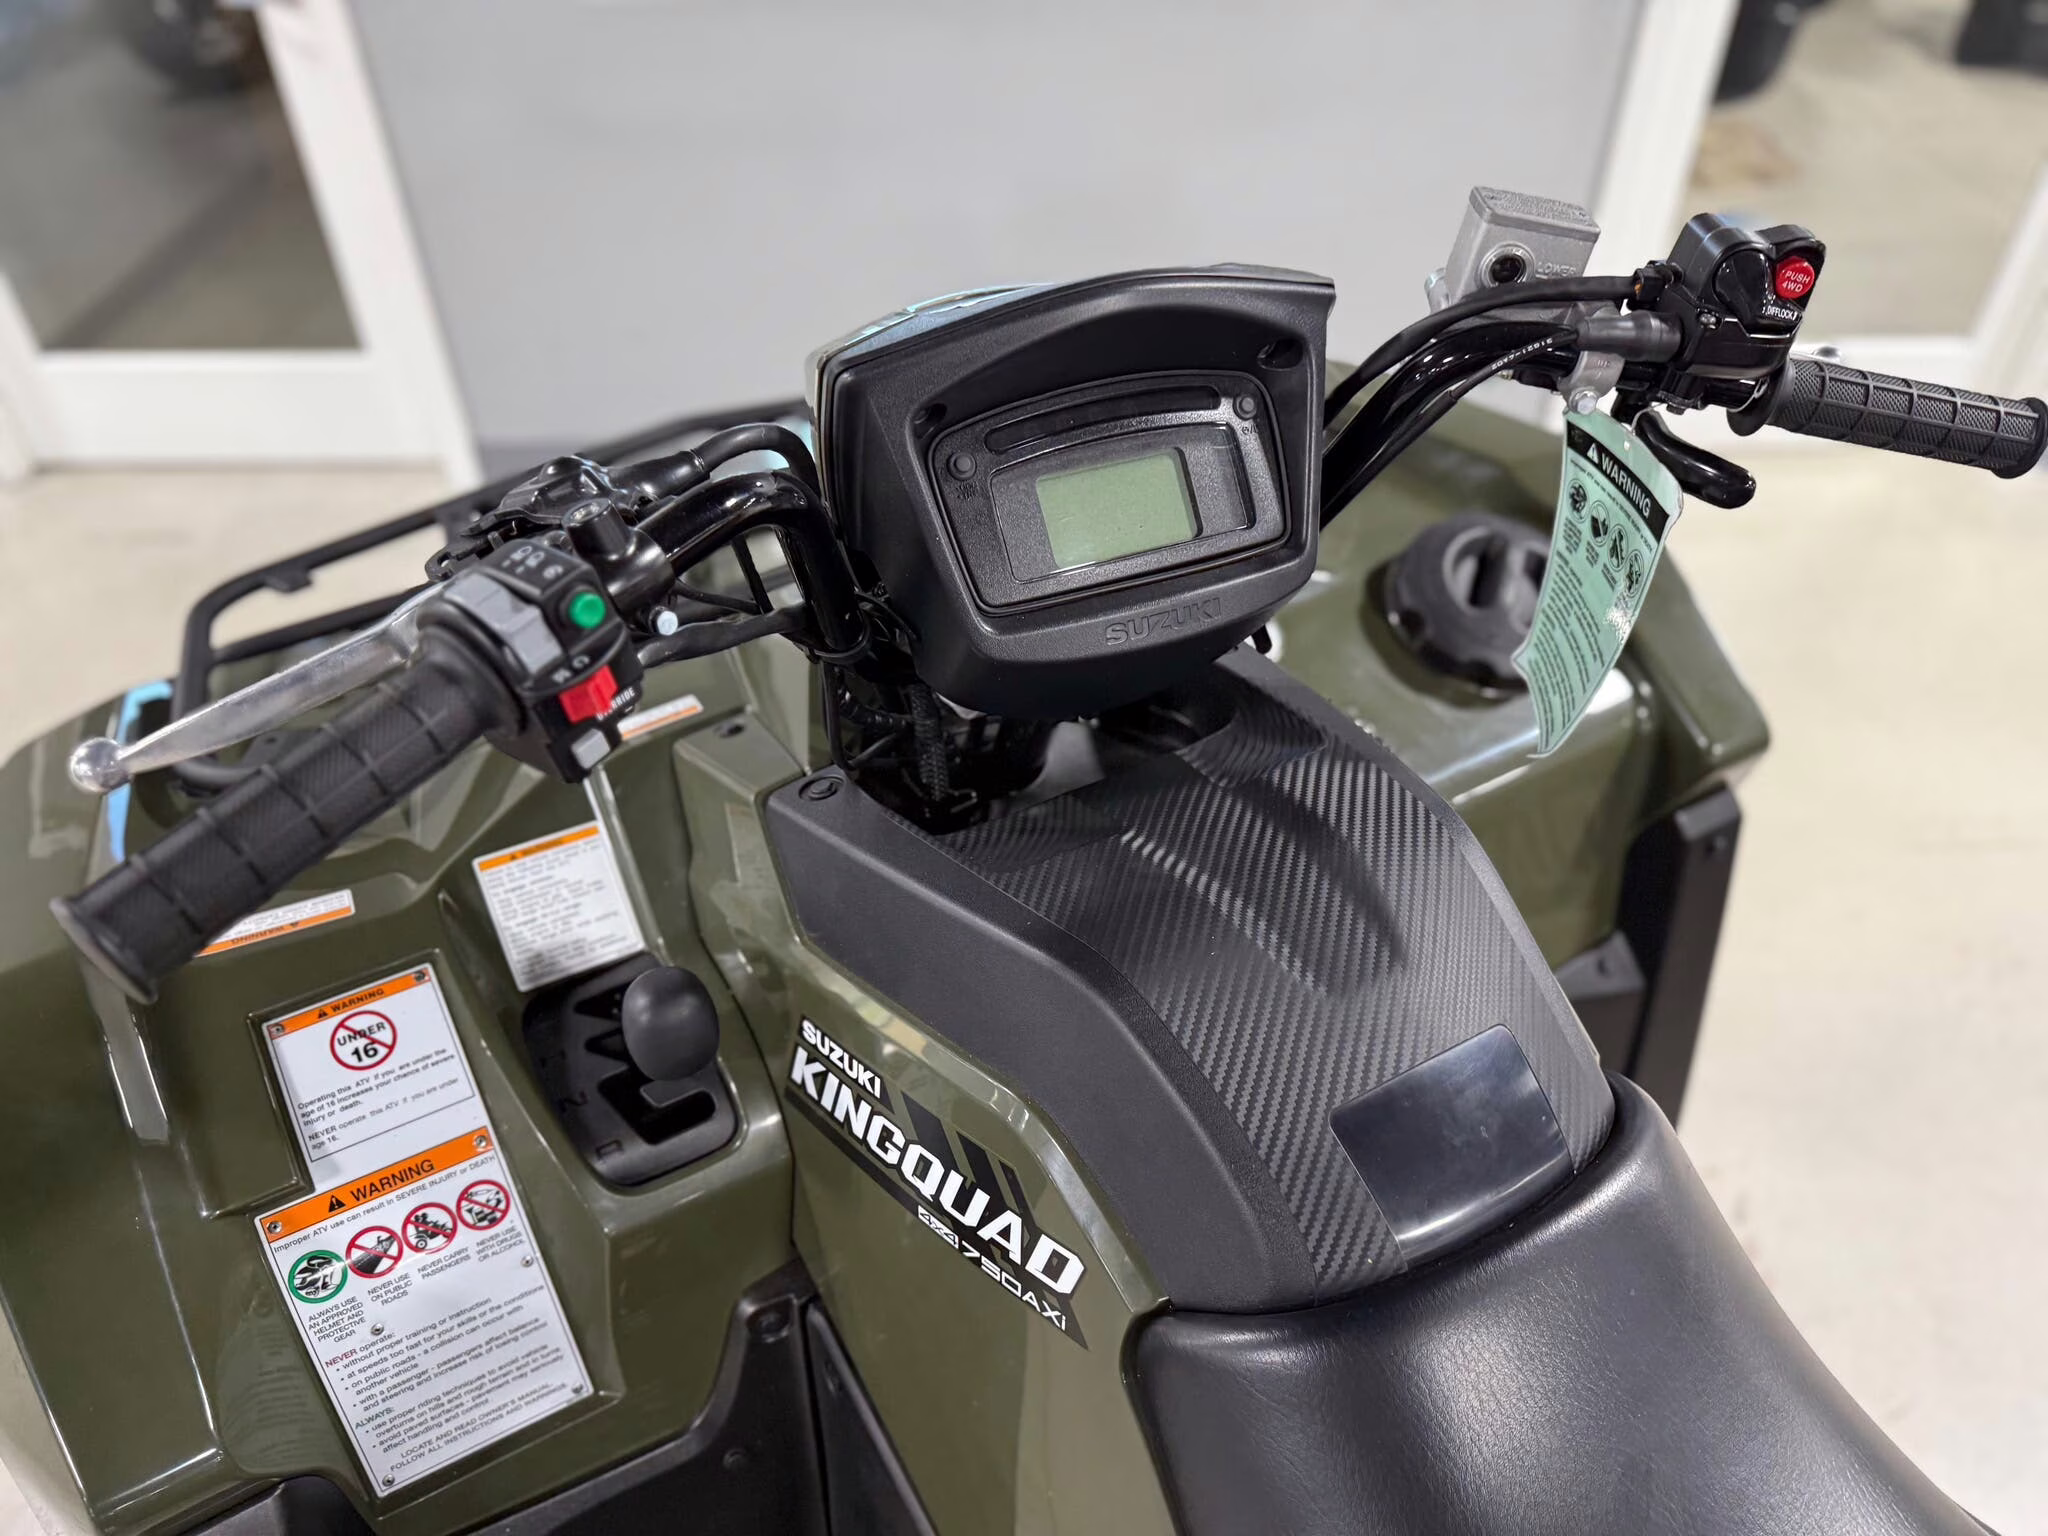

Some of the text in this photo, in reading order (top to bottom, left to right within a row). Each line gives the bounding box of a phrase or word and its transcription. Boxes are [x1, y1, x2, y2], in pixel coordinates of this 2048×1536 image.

[1782, 280, 1803, 292] 4WD
[1784, 270, 1811, 284] PUSH
[1601, 452, 1651, 519] WARNING
[1105, 597, 1221, 646] SUZUKI
[330, 988, 384, 1012] WARNING
[336, 1021, 385, 1046] UNDER
[351, 1039, 378, 1063] 16
[801, 1019, 881, 1099] SUZUKI
[296, 1091, 336, 1111] Operating
[336, 1084, 352, 1095] this
[355, 1076, 370, 1087] ATV
[380, 1068, 395, 1078] you
[411, 1053, 433, 1065] under
[300, 1108, 315, 1119] age
[316, 1103, 325, 1112] of
[325, 1099, 335, 1108] 16
[336, 1085, 373, 1103] increases
[374, 1078, 391, 1090] your
[393, 1067, 420, 1082] chance
[421, 1062, 429, 1071] of
[302, 1114, 325, 1128] injury
[327, 1109, 335, 1117] or
[307, 1125, 336, 1141] NEVER
[338, 1114, 366, 1129] operate
[369, 1107, 383, 1116] this
[384, 1100, 399, 1110] ATV
[411, 1091, 425, 1101] you
[425, 1086, 437, 1094] are
[311, 1140, 325, 1150] age
[350, 1159, 434, 1201] WARNING
[790, 1045, 1085, 1295] KINGQUAD
[273, 1233, 310, 1253] Improper
[312, 1225, 328, 1237] ATV
[329, 1219, 345, 1229] use
[346, 1212, 361, 1222] can
[362, 1201, 385, 1215] result
[395, 1183, 427, 1201] SEVERE
[468, 1155, 495, 1170] DEATH
[417, 1246, 468, 1273] NEVER CARRY
[421, 1254, 470, 1279] PASSENGERS
[367, 1272, 410, 1295] NEVER USE
[370, 1279, 412, 1302] ON PUBLIC
[380, 1289, 408, 1306] ROADS
[961, 1240, 1067, 1332] 750AXi
[308, 1295, 358, 1322] ALWAYS USE
[308, 1301, 363, 1330] AN APPROVED
[313, 1309, 364, 1336] HELMET AND
[317, 1316, 365, 1342] PROTECTIVE
[333, 1329, 356, 1343] GEAR
[342, 1297, 491, 1369] without proper training or instruction
[324, 1332, 395, 1368] NEVER operate:
[346, 1370, 356, 1379] at
[357, 1356, 389, 1374] speeds
[389, 1348, 404, 1359] too
[405, 1339, 422, 1351] fast
[422, 1334, 435, 1343] for
[436, 1325, 455, 1338] your
[478, 1310, 487, 1318] or
[351, 1379, 363, 1388] on
[364, 1366, 390, 1383] public
[391, 1354, 416, 1369] roads
[465, 1324, 480, 1335] can
[355, 1362, 419, 1395] another vehicle
[359, 1393, 377, 1405] with
[386, 1368, 429, 1393] passenger
[363, 1400, 379, 1412] and
[381, 1384, 415, 1403] steering
[415, 1375, 432, 1387] and
[468, 1351, 483, 1361] risk
[484, 1345, 493, 1354] of
[354, 1406, 394, 1429] ALWAYS:
